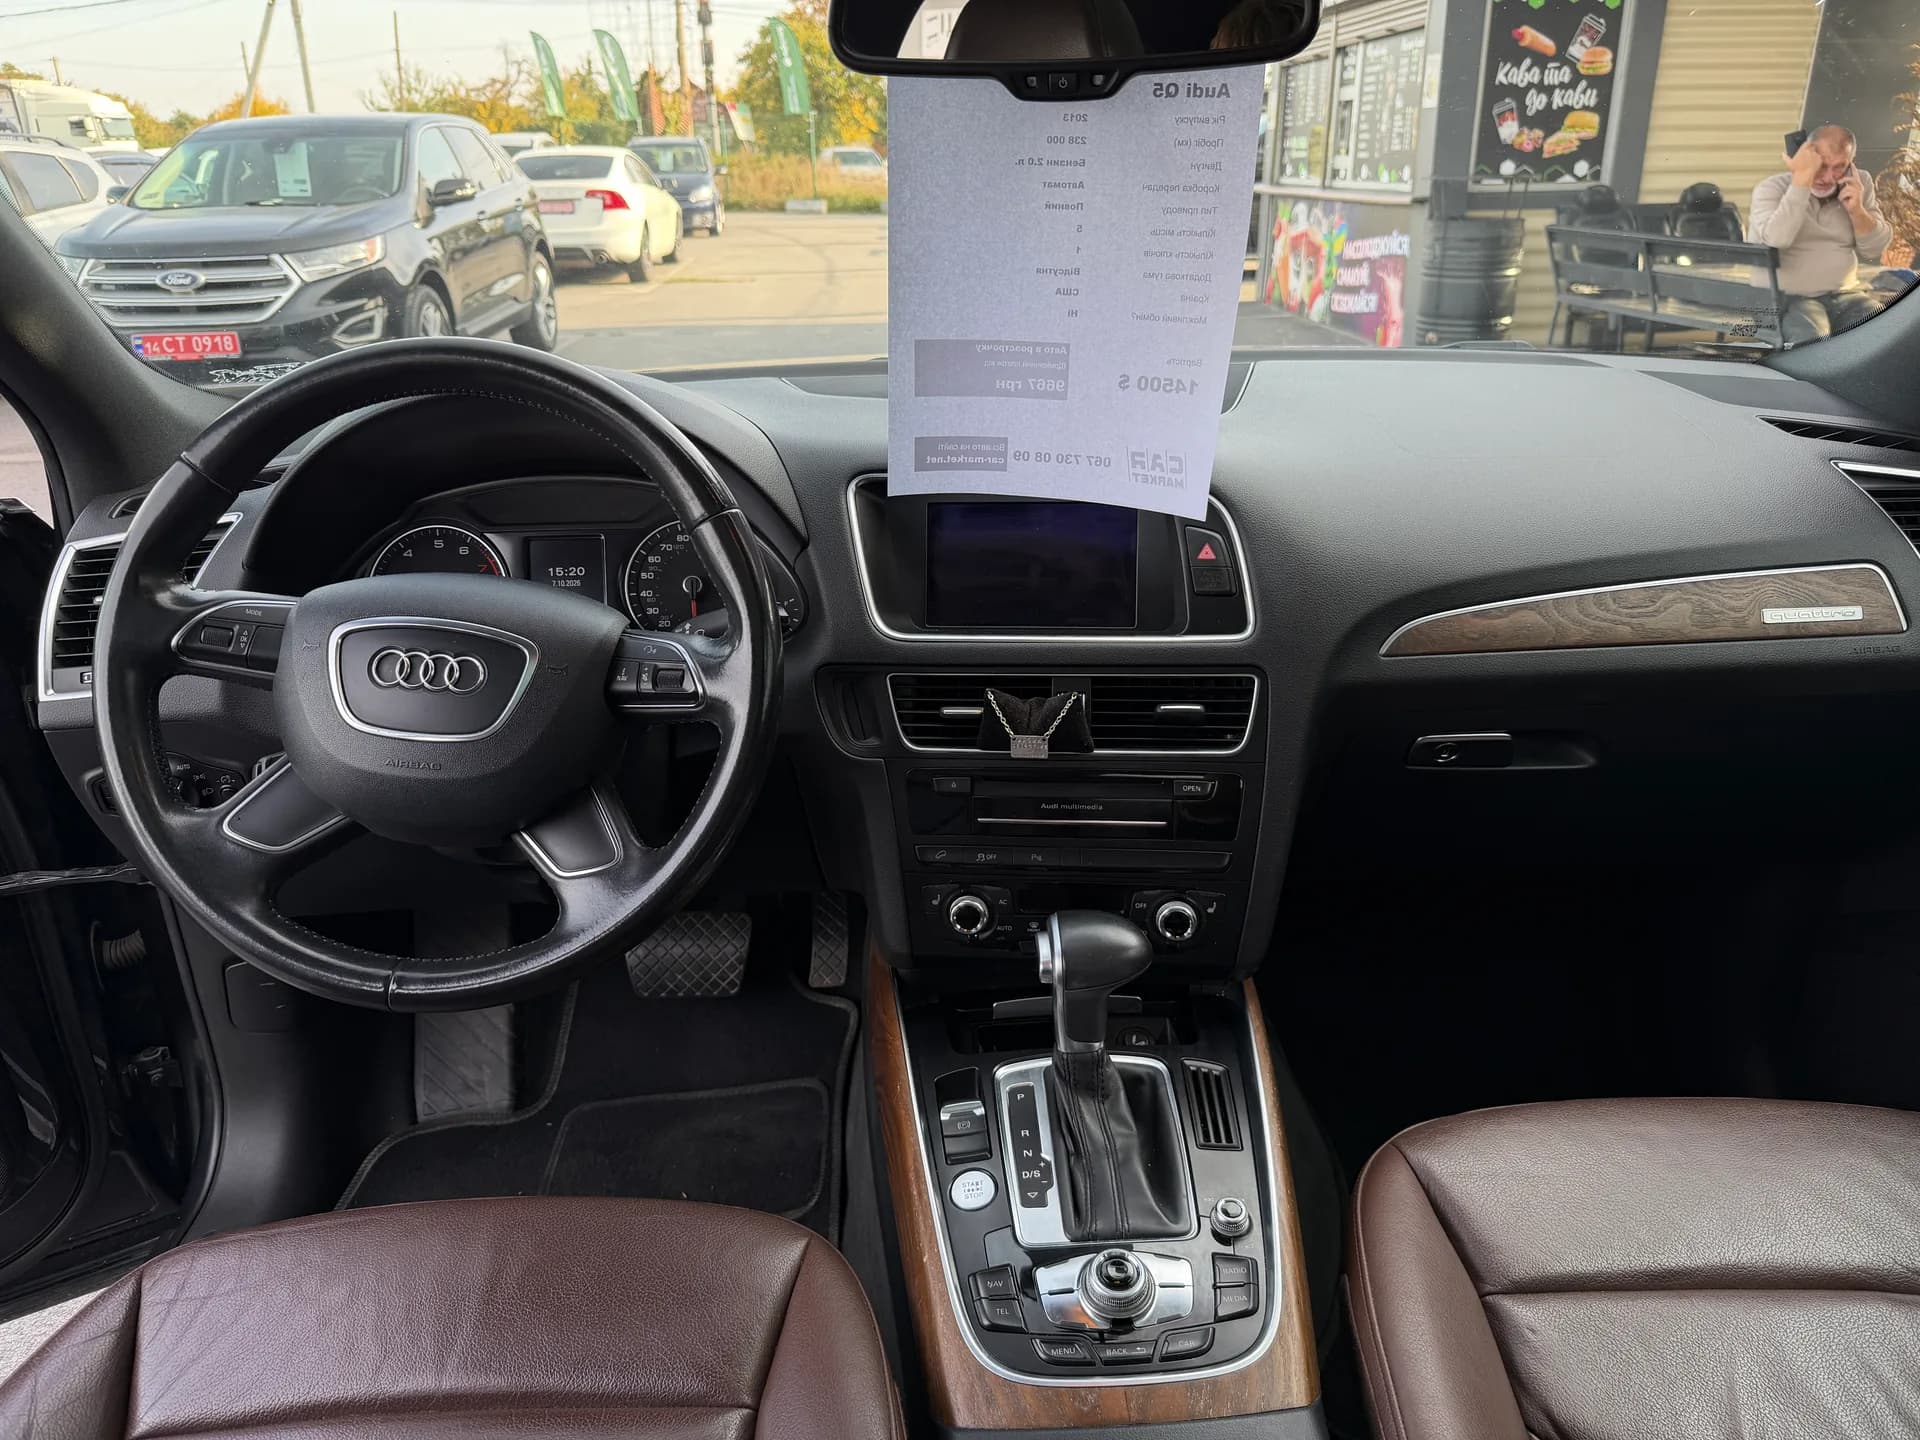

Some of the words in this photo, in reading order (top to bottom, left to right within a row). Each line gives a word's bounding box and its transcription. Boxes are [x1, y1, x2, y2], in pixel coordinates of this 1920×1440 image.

[1495, 57, 1541, 88] Кава
[1543, 62, 1573, 86] та
[1525, 88, 1548, 116] до
[1551, 79, 1599, 110] кави
[166, 272, 193, 286] Ford
[144, 341, 160, 355] 14
[162, 336, 186, 353] CT
[191, 335, 234, 353] 0918
[676, 534, 690, 542] 80
[433, 539, 445, 548] 5
[402, 549, 413, 557] 4
[458, 546, 470, 555] 6
[478, 564, 488, 573] 7
[548, 566, 586, 577] 15:20
[640, 572, 654, 580] 50
[245, 607, 262, 617] MODE
[646, 607, 660, 615] 30
[1770, 609, 1856, 621] quattro
[658, 620, 671, 628] 20
[240, 635, 248, 643] OK
[176, 763, 191, 771] AUTO
[384, 758, 442, 770] AIRBAG
[1040, 802, 1059, 810] Audi
[1060, 802, 1104, 811] multimedia
[1016, 1093, 1025, 1101] P
[1023, 1149, 1033, 1157] N
[1022, 1170, 1041, 1179] D/S
[961, 1180, 984, 1189] START
[964, 1192, 984, 1200] STOP
[987, 1280, 1004, 1289] NAV
[1222, 1295, 1248, 1303] MEDIA
[1178, 1340, 1196, 1348] CAR
[1051, 1347, 1076, 1356] MENU
